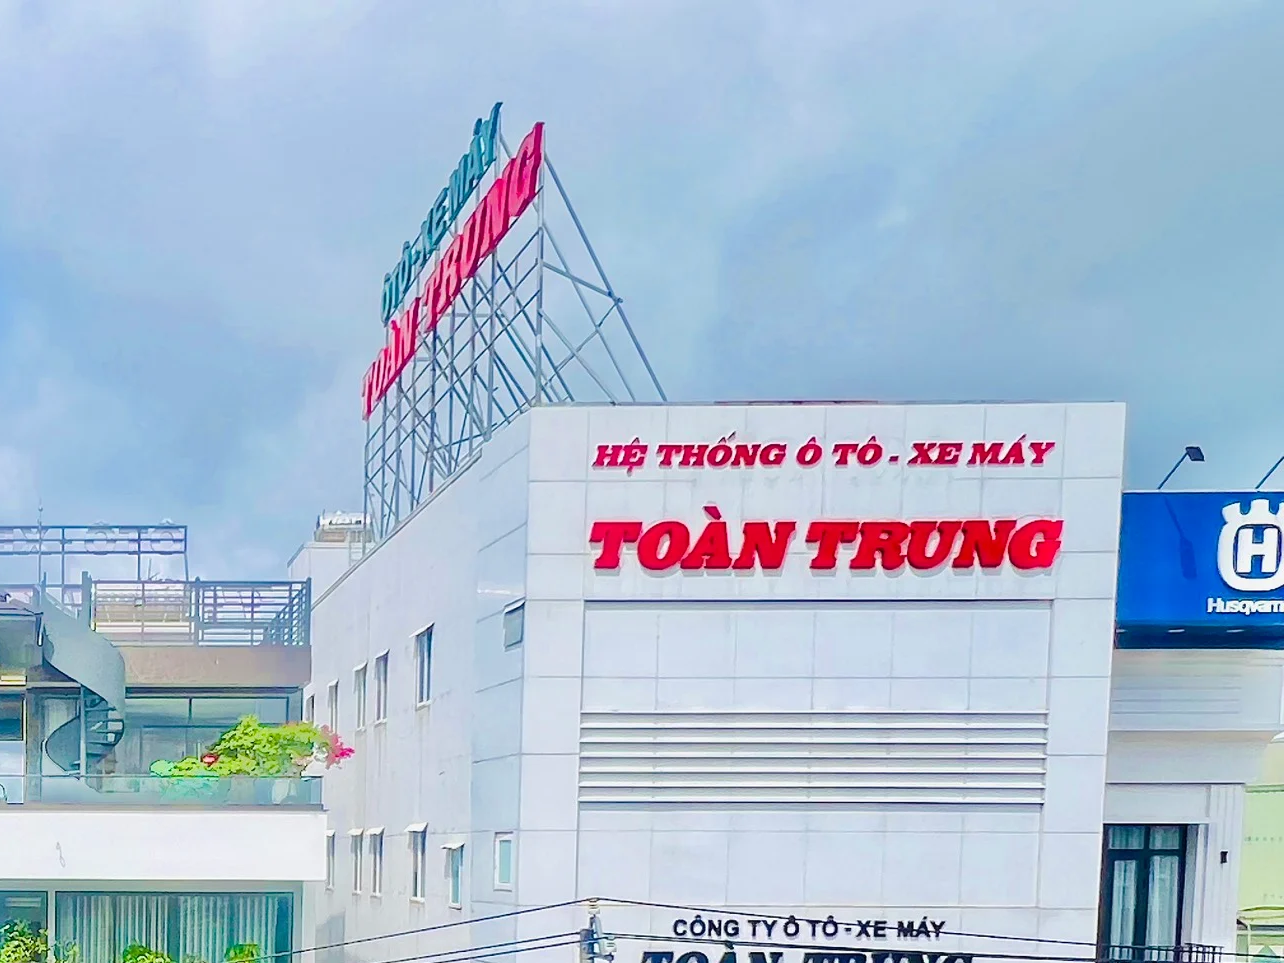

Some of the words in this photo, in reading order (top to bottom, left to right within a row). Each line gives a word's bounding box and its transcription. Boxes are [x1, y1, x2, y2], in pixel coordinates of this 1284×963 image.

[362, 297, 422, 421] TOÀN
[421, 122, 545, 333] TRUNG
[592, 437, 648, 477] HỆ
[656, 431, 787, 468] THỐNG
[796, 437, 823, 468] Ô
[832, 436, 883, 467] TÔ
[907, 442, 963, 467] XE
[967, 434, 1055, 467] MÁY
[589, 505, 797, 571] TOÀN
[805, 519, 1064, 571] TRUNG
[673, 914, 739, 937] CÔNG
[748, 920, 777, 938] TY
[807, 915, 838, 937] TÔ
[856, 920, 887, 938] XE
[896, 916, 946, 938] MÁY
